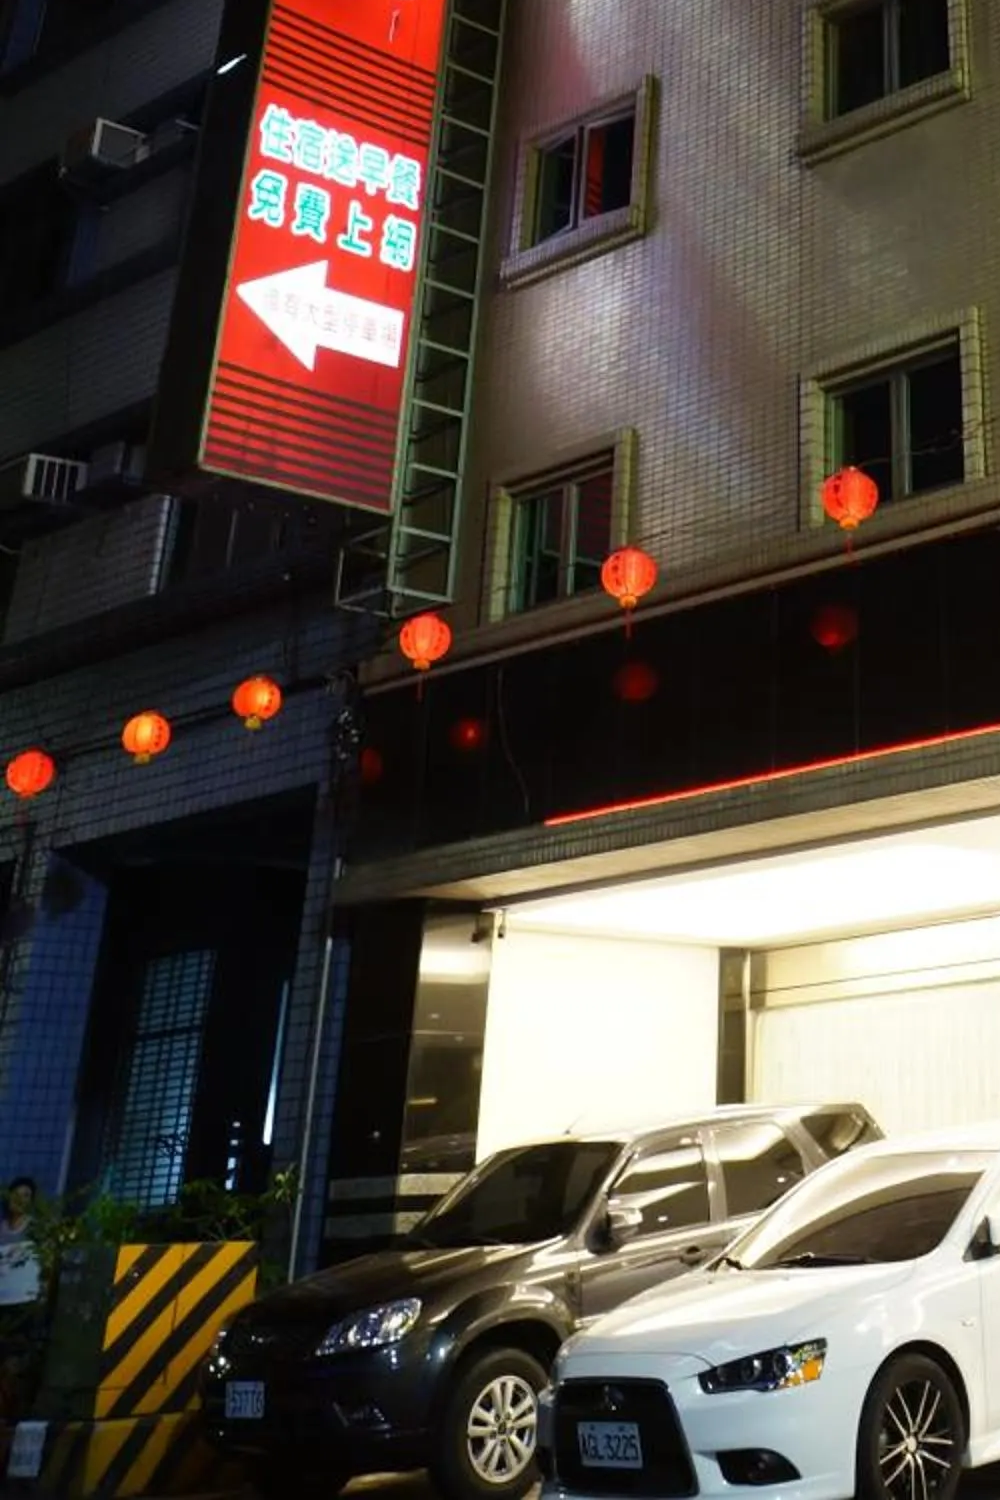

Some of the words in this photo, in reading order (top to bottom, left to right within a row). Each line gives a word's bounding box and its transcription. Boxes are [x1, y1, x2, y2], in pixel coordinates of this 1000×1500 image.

[260, 103, 421, 211] 住宿送早餐
[250, 169, 417, 273] 免費上網
